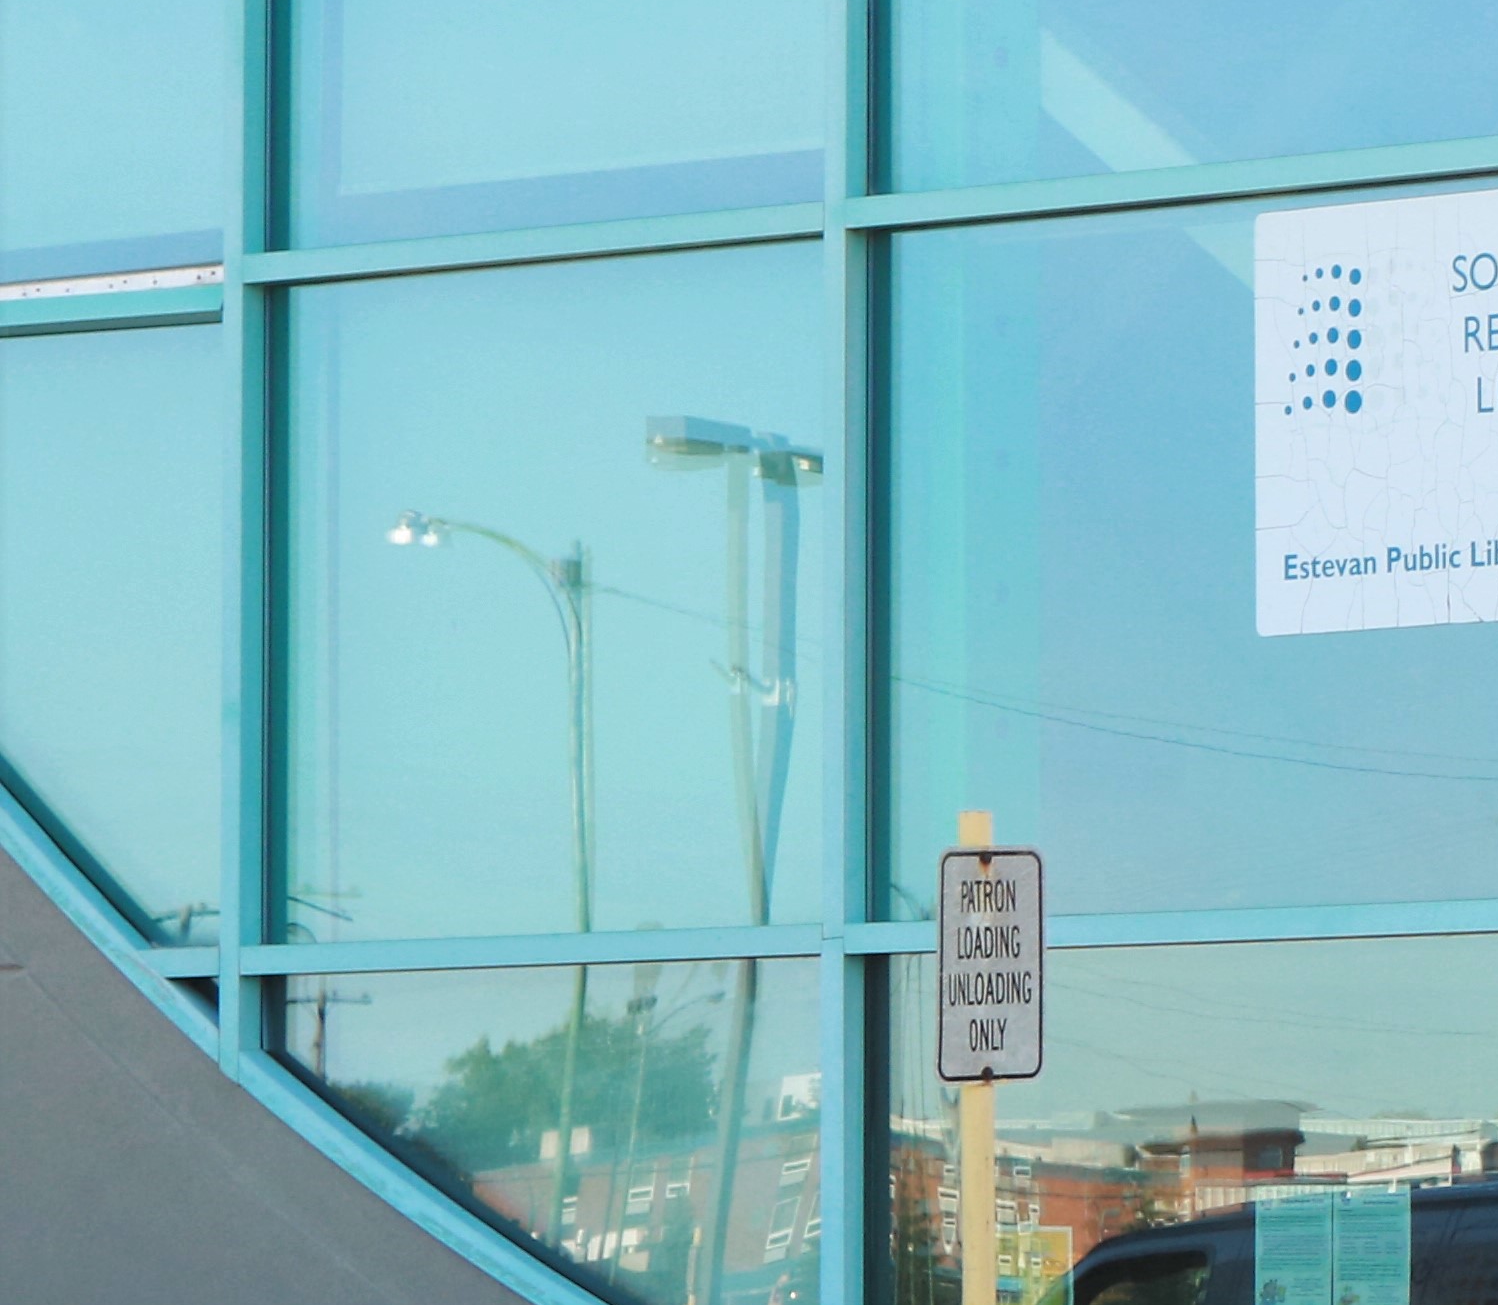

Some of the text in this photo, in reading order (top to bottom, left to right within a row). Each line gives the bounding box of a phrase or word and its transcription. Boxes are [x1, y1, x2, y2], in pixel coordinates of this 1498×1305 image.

[1283, 552, 1378, 581] Estevan
[1386, 542, 1462, 573] Public
[960, 878, 1017, 914] PATRON
[957, 925, 1021, 960] LOADING
[947, 970, 1033, 1007] UNLOADING
[968, 1017, 1008, 1053] ONLY
